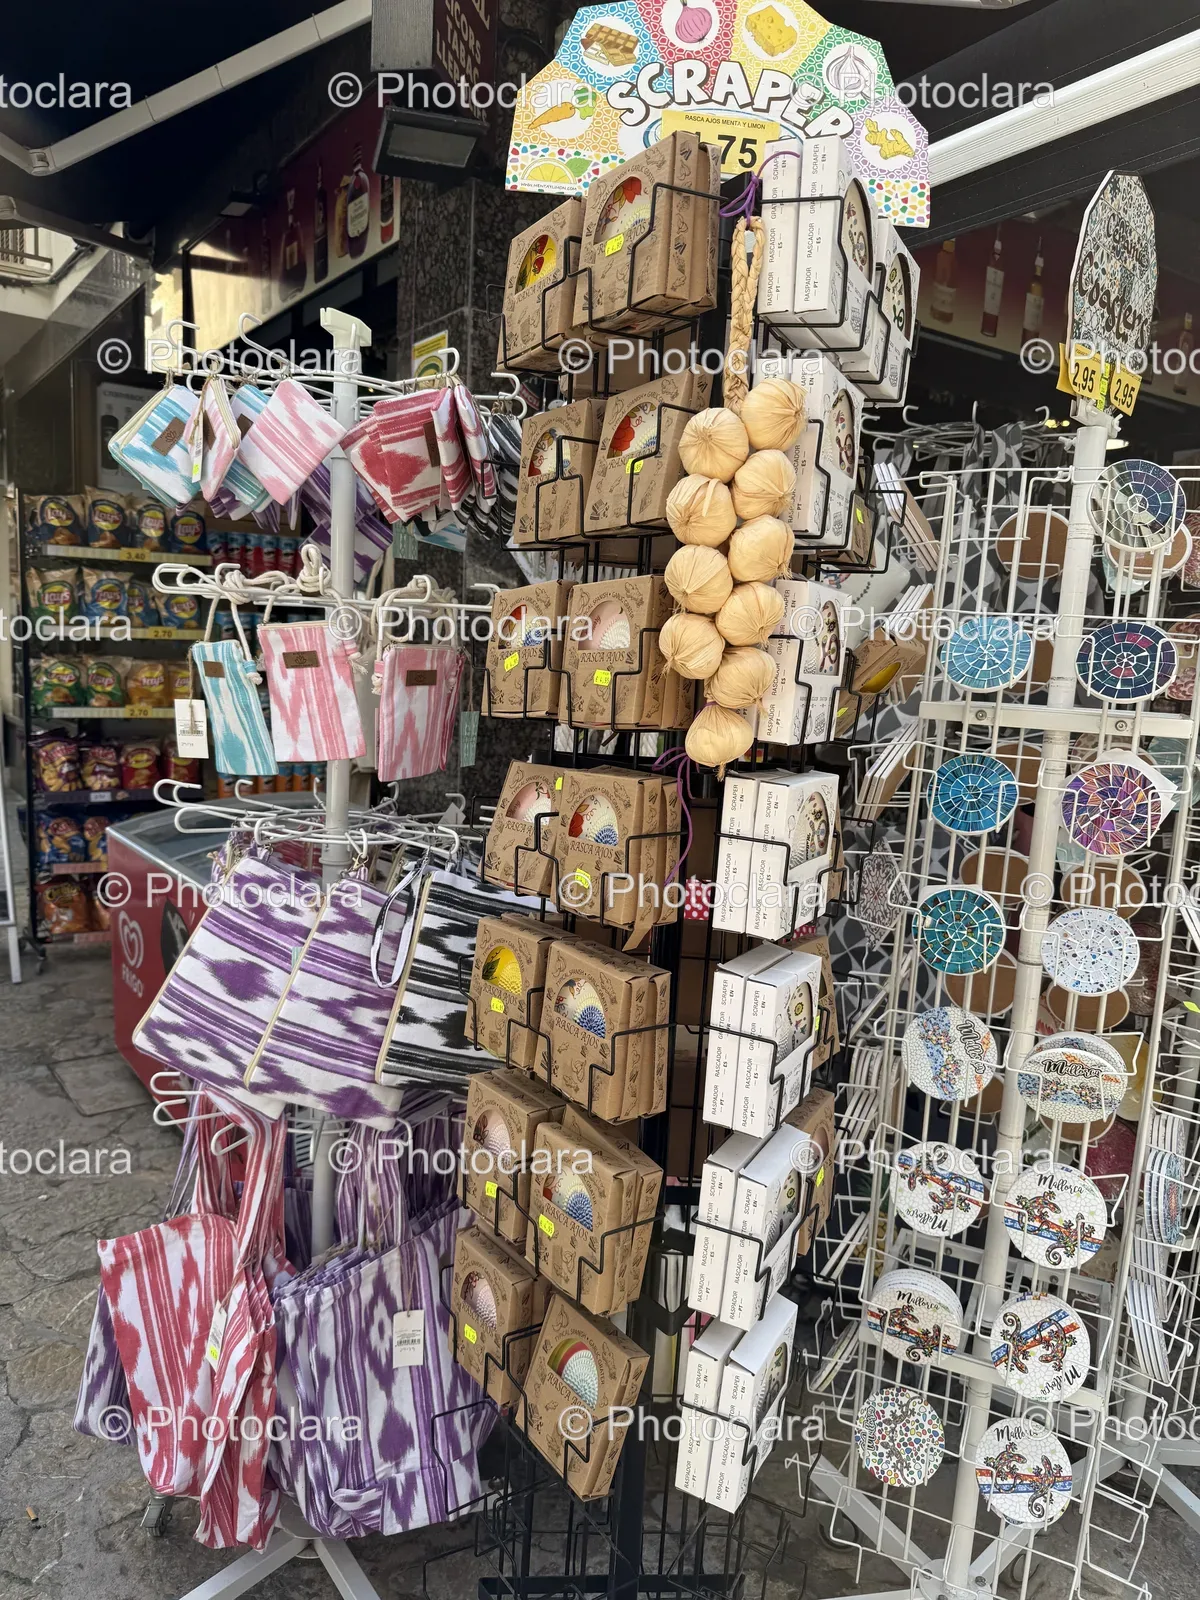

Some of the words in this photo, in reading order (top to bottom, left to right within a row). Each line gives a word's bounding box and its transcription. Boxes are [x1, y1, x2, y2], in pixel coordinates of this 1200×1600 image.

[606, 59, 855, 140] SCRAPER
[722, 119, 741, 127] MENTA
[748, 122, 766, 130] LIMON
[700, 132, 758, 168] 75
[811, 143, 820, 175] SCRAPER
[769, 227, 777, 263] RASCADOR
[807, 222, 815, 258] RASCADOR
[767, 271, 775, 306] RASPADOR
[804, 266, 812, 302] RASPADOR
[1071, 362, 1096, 394] 2,95
[1112, 378, 1135, 410] 2,95
[580, 651, 605, 664] RASCA
[606, 650, 626, 664] AJOS
[766, 703, 776, 737] RASPADOR
[731, 784, 739, 812] SCRAPER
[765, 791, 774, 819] SCRAPER
[569, 840, 594, 856] RASCA
[595, 847, 614, 860] AJOS
[724, 852, 732, 885] RASCADOR
[720, 979, 729, 1007] SCRAPER
[752, 990, 761, 1018] SCRAPER
[554, 1016, 580, 1039] RASCA
[580, 1031, 600, 1050] AJOS
[714, 1045, 723, 1079] RASCADOR
[744, 1057, 753, 1090] RASCADOR
[711, 1084, 720, 1117] RASPADOR
[742, 1095, 750, 1128] RASPADOR
[709, 1170, 718, 1198] SCRAPER
[1037, 1173, 1085, 1195] Mallorca
[743, 1188, 753, 1216] SCRAPER
[544, 1202, 570, 1228] RASCA
[570, 1220, 590, 1241] AJOS
[905, 1209, 948, 1231] Mallorca
[701, 1236, 710, 1267] RASCADOR
[735, 1254, 744, 1286] RASCADOR
[697, 1272, 706, 1303] RASPADOR
[896, 1290, 941, 1310] Mallorca
[729, 1289, 739, 1321] RASPADOR
[547, 1370, 572, 1402] RASCA
[683, 1459, 693, 1491] RASPADOR
[716, 1471, 726, 1502] RASPADOR
